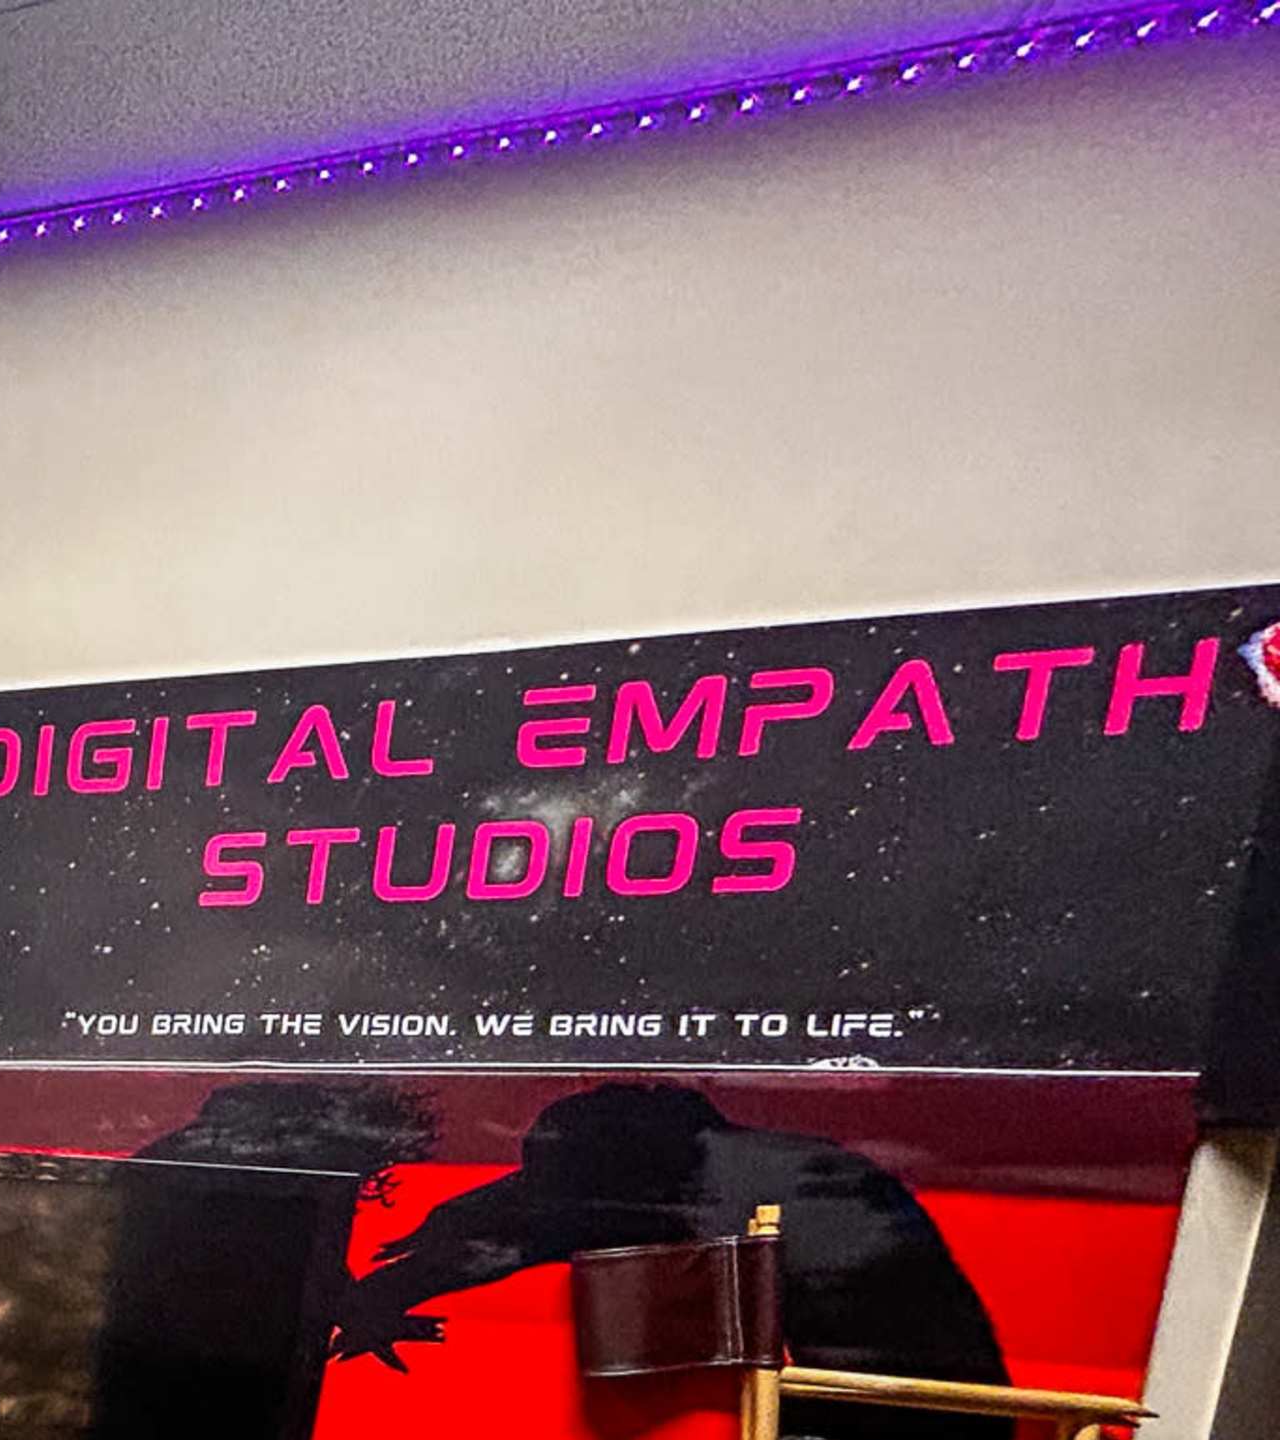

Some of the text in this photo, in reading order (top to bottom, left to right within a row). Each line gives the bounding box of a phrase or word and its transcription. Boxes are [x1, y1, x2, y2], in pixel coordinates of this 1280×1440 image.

[516, 637, 1221, 769] EMPATH
[197, 807, 803, 908] STUDIOS
[151, 1012, 246, 1036] BRING
[259, 1013, 324, 1036] THE
[338, 1012, 457, 1037] VISION.
[474, 1012, 535, 1037] WE
[548, 1013, 662, 1038] BRING
[677, 1013, 717, 1038] IT
[733, 1013, 789, 1038] TO
